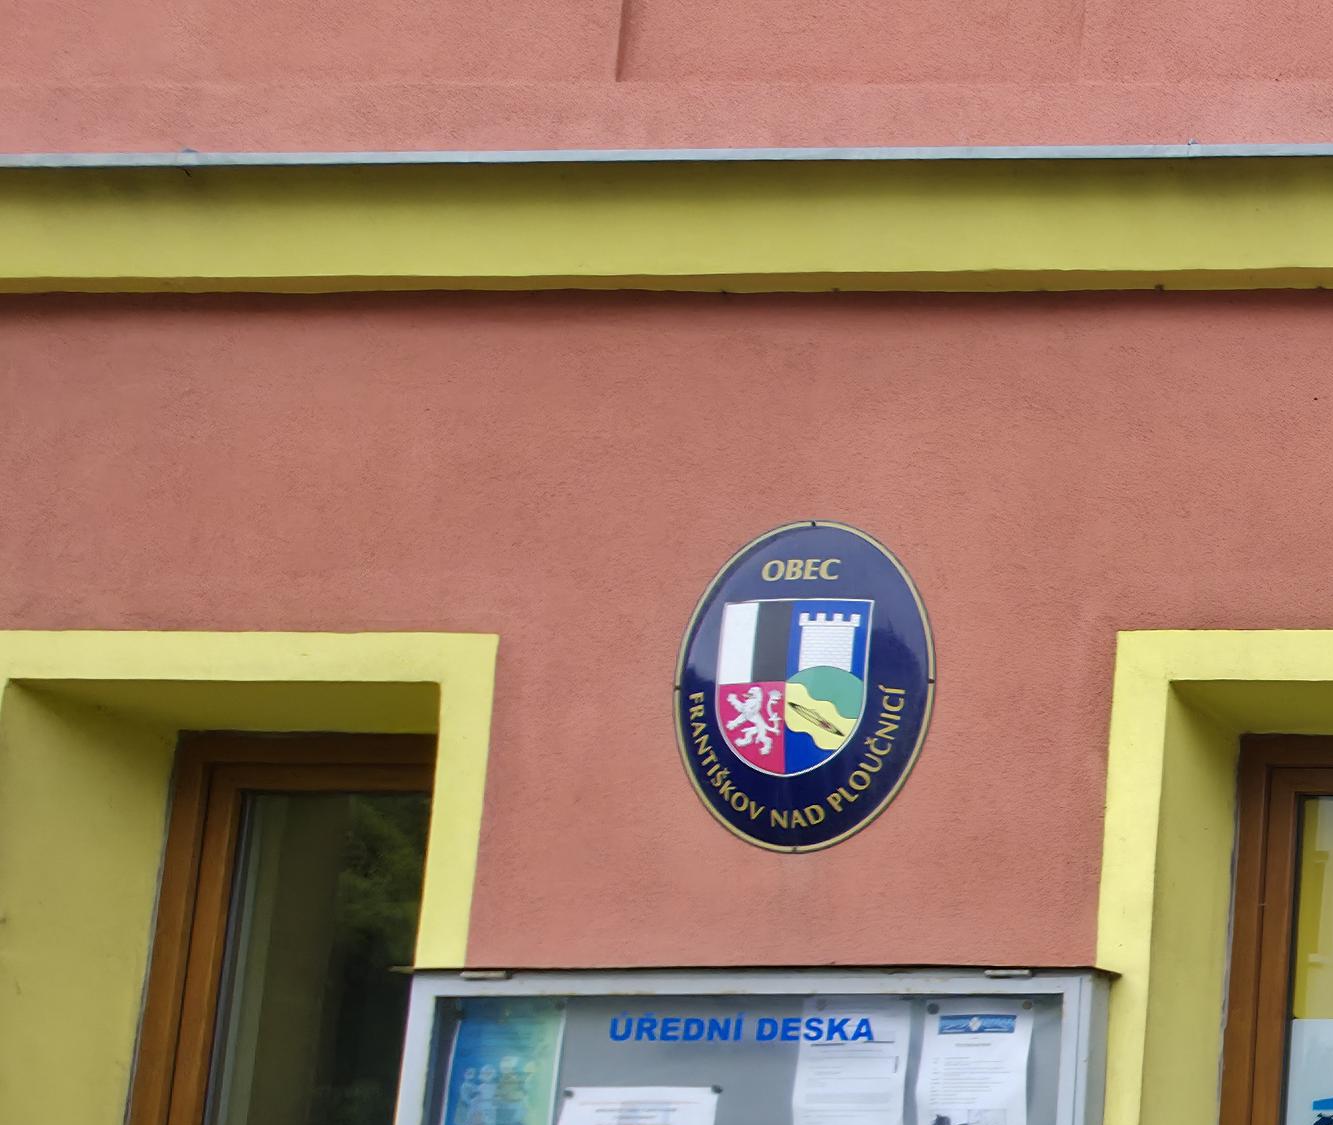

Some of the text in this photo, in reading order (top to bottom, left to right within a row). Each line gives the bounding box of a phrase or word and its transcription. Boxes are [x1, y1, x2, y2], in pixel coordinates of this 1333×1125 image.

[761, 558, 841, 581] OBEC
[688, 684, 906, 829] FRANTIŠKOV NAD PLOUČNICÍ
[609, 1011, 875, 1041] ÚŘEDNÍ DESKA
